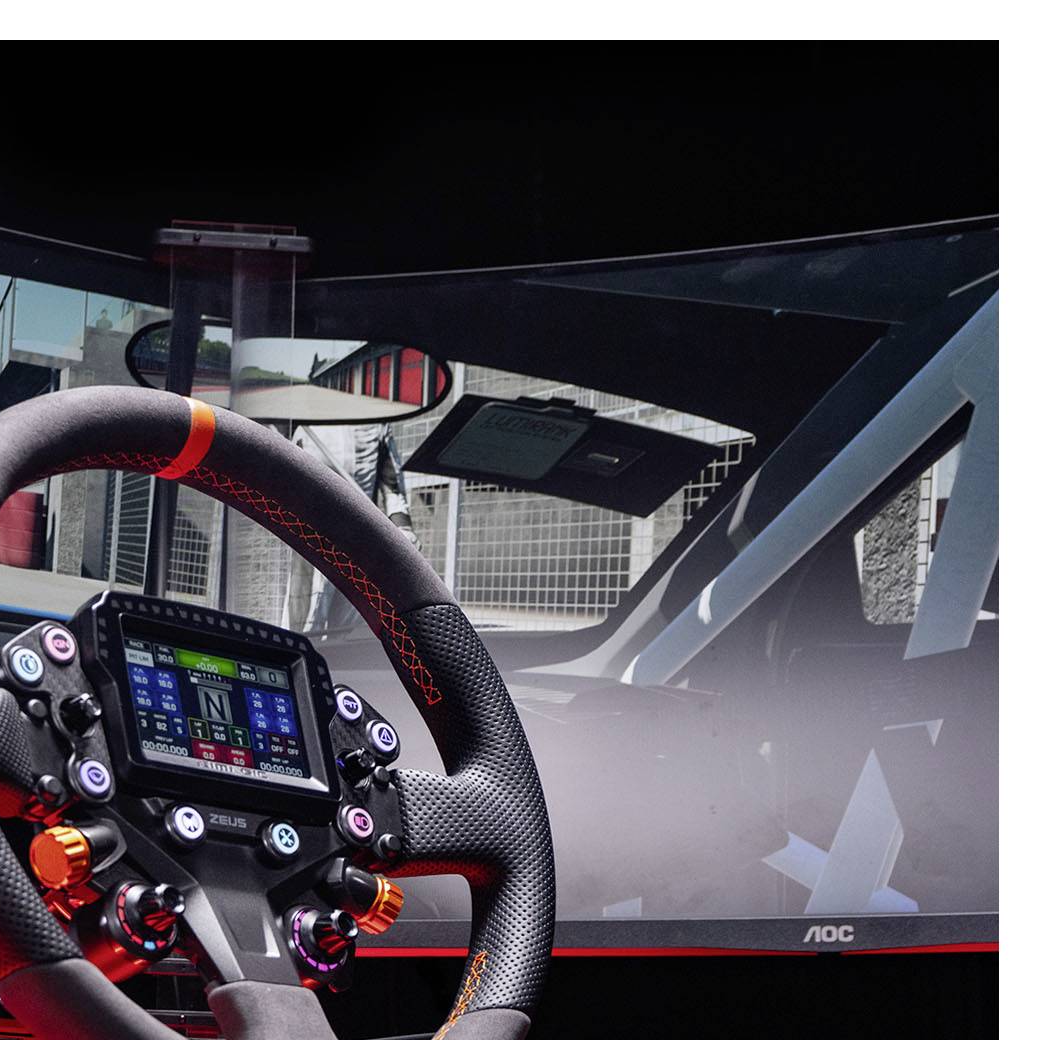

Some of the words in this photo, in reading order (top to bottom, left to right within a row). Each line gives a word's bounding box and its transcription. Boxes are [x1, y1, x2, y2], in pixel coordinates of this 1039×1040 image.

[204, 692, 228, 723] N
[209, 813, 247, 828] ZEUS
[803, 925, 855, 943] AOC
